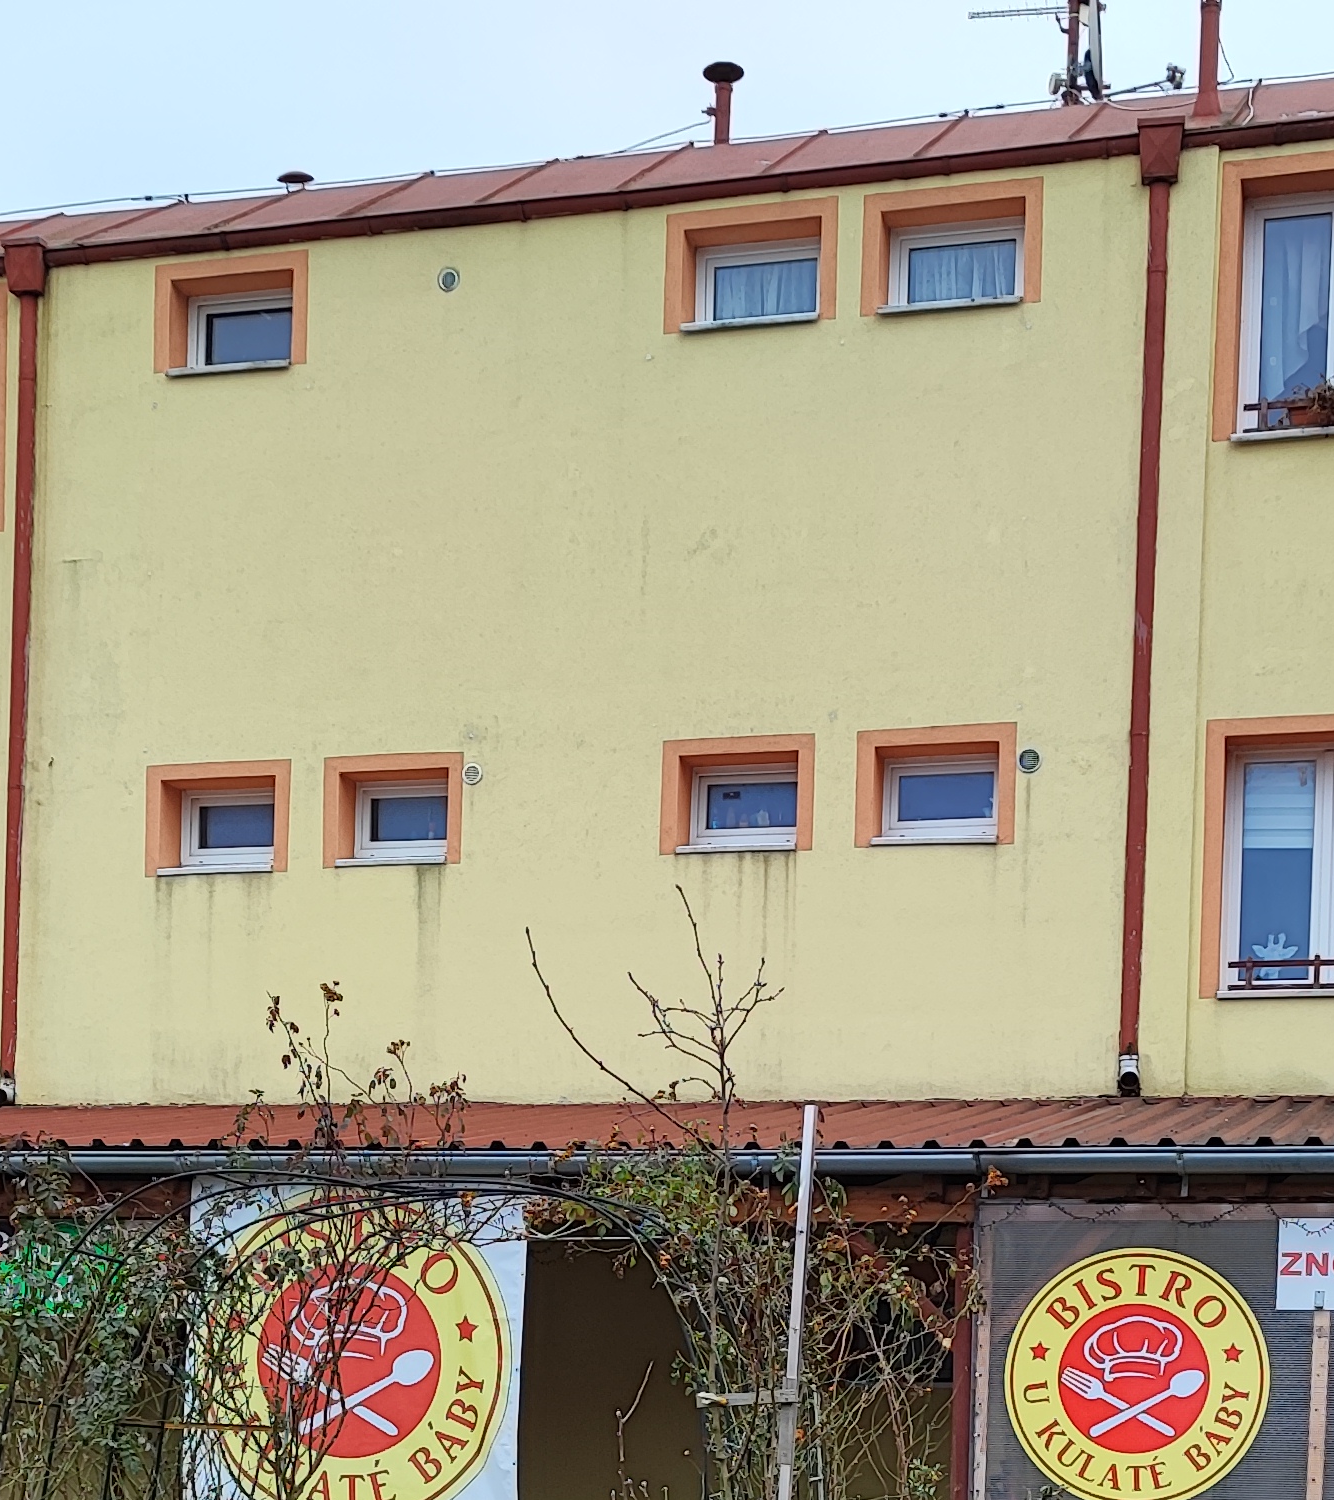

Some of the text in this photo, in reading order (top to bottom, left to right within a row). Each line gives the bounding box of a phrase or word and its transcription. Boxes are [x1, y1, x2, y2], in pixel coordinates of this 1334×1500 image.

[1045, 1264, 1227, 1330] BISTRO
[408, 1366, 485, 1484] BÁBY
[1023, 1380, 1250, 1492] U KULATÉ BÁBY
